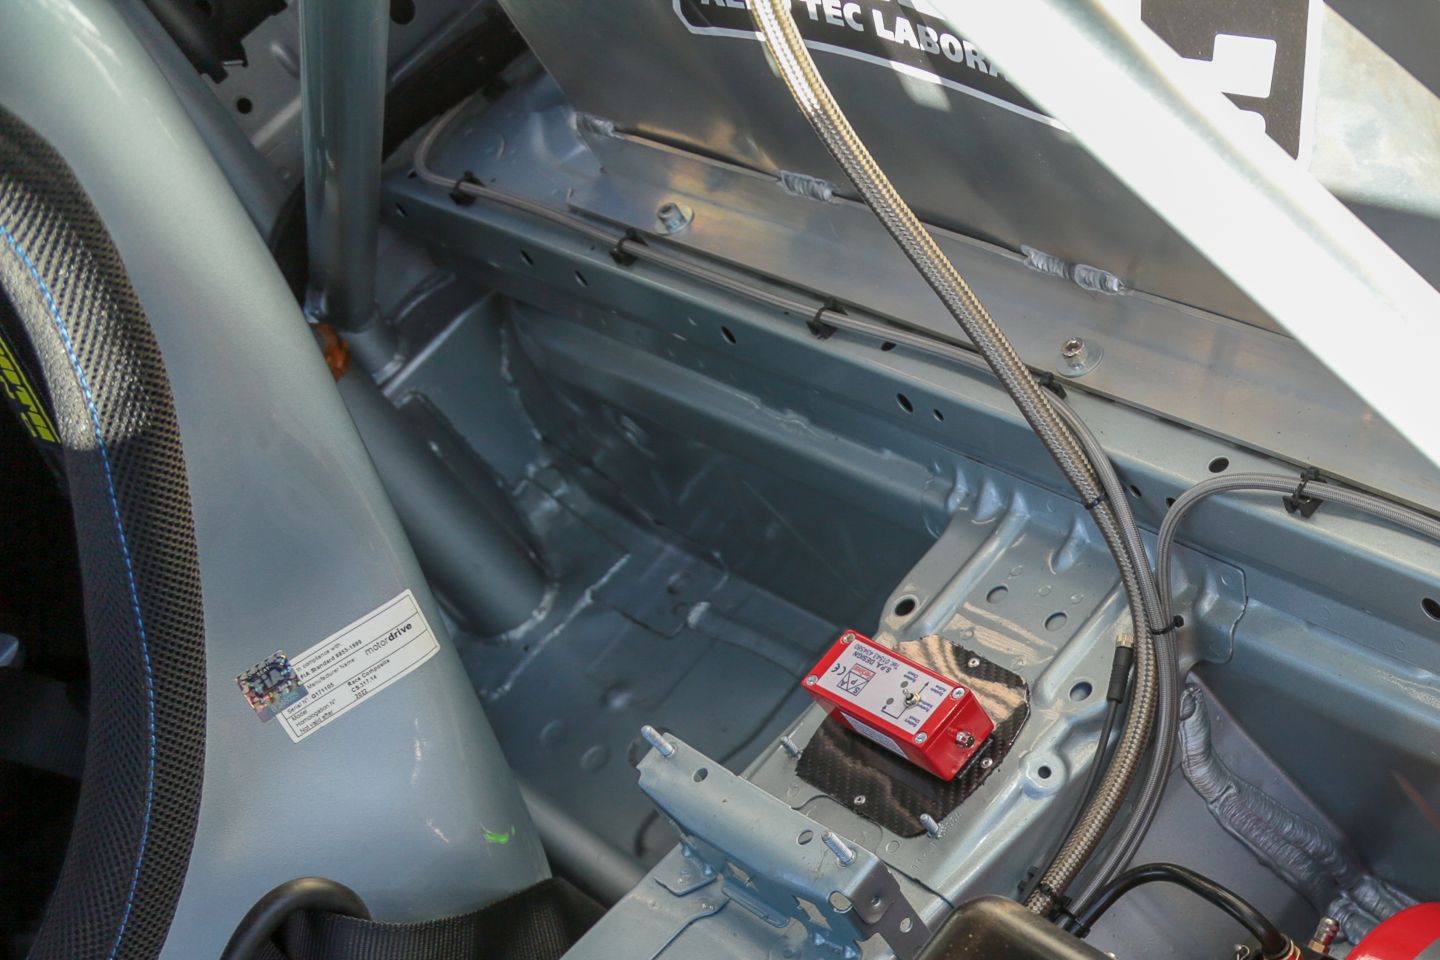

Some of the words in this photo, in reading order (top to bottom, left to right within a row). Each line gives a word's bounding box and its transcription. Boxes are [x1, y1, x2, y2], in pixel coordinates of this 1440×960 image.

[803, 0, 865, 33] TEC
[305, 666, 339, 690] Manufacturer
[338, 656, 356, 670] Name
[364, 621, 413, 656] motordrive
[309, 654, 336, 673] Standard
[851, 649, 876, 665] DESIGN
[290, 707, 308, 722] Model
[346, 675, 361, 687] Race
[360, 657, 391, 679] Composite
[286, 700, 303, 714] Serial
[294, 702, 330, 727] Homologation
[299, 723, 311, 734] Not
[309, 715, 323, 727] valid
[321, 708, 334, 720] after
